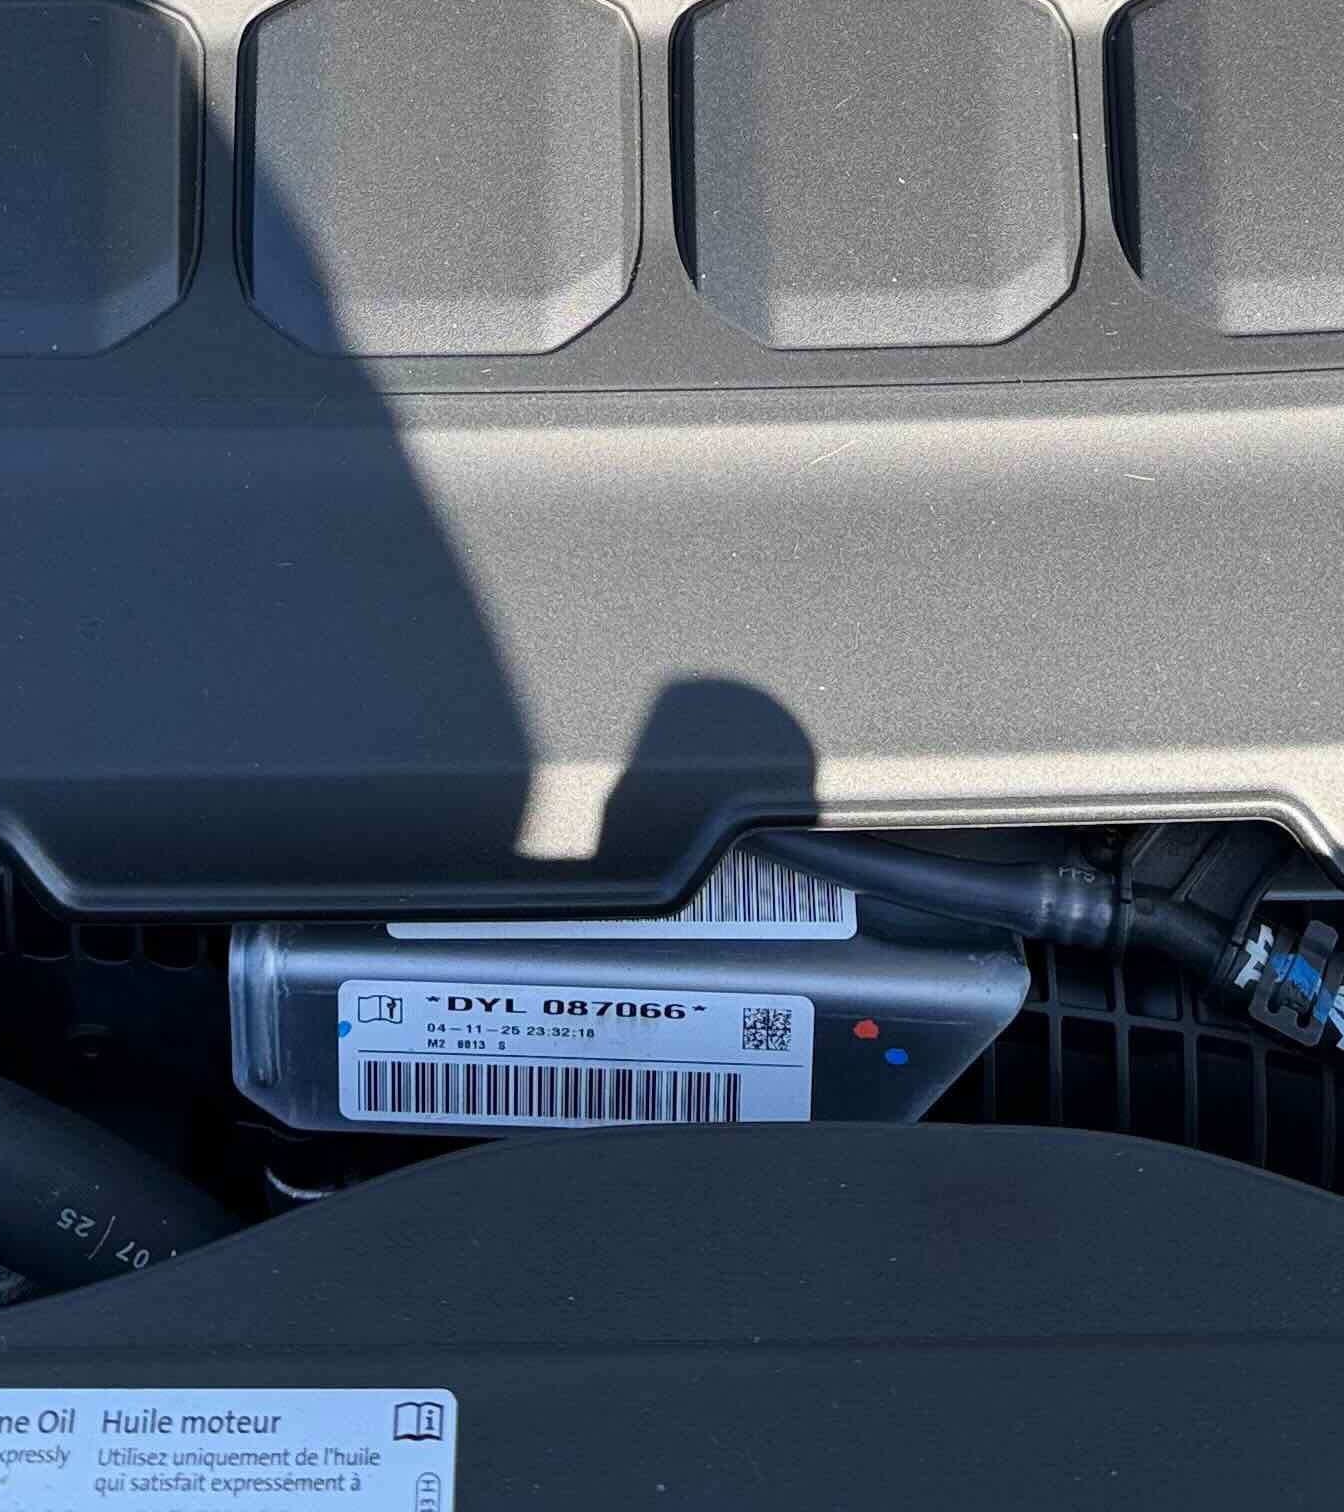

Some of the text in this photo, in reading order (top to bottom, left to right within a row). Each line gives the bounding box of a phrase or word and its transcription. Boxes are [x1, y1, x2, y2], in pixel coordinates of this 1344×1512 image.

[56, 1206, 152, 1270] 07 25
[37, 1407, 77, 1435] Oil
[102, 1407, 283, 1435] Huile moteur
[97, 1447, 382, 1471] Utilisez uniquement de l'huile
[93, 1472, 362, 1497] qui satisfait expressément à
